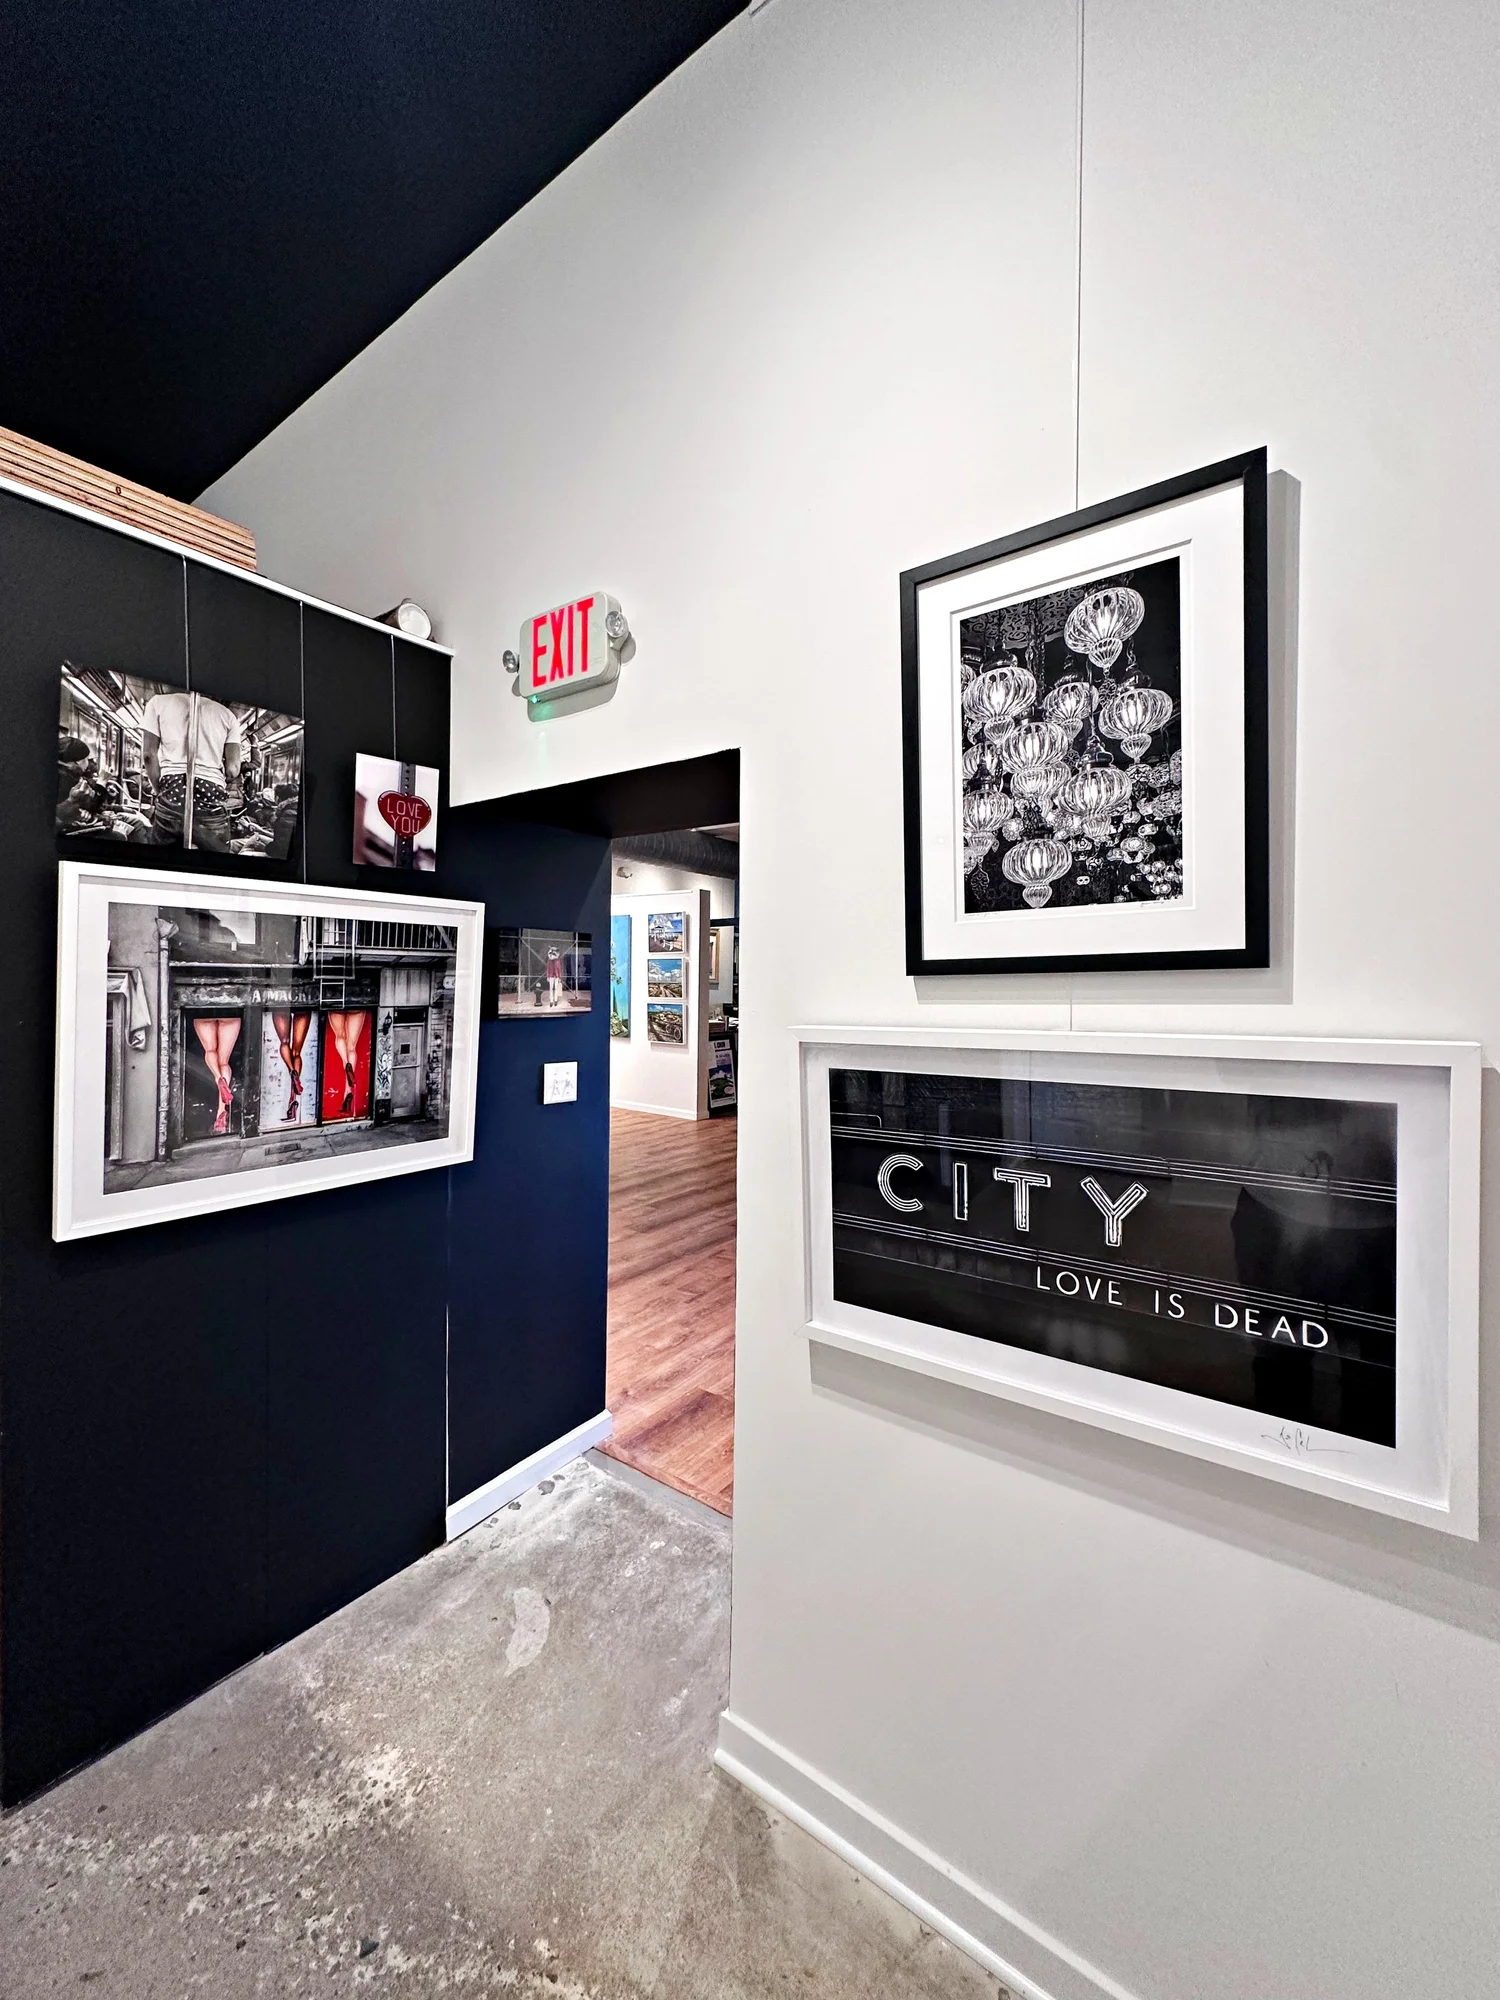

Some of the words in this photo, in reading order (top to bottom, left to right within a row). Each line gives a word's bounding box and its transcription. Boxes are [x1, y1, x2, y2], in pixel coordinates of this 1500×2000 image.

[532, 597, 594, 688] EXIT
[387, 798, 422, 819] LOVE
[391, 814, 420, 834] YOU
[877, 1153, 1149, 1247] CITY
[1037, 1266, 1123, 1306] LOVE
[1154, 1290, 1185, 1319] IS
[1214, 1303, 1329, 1349] DEAD
